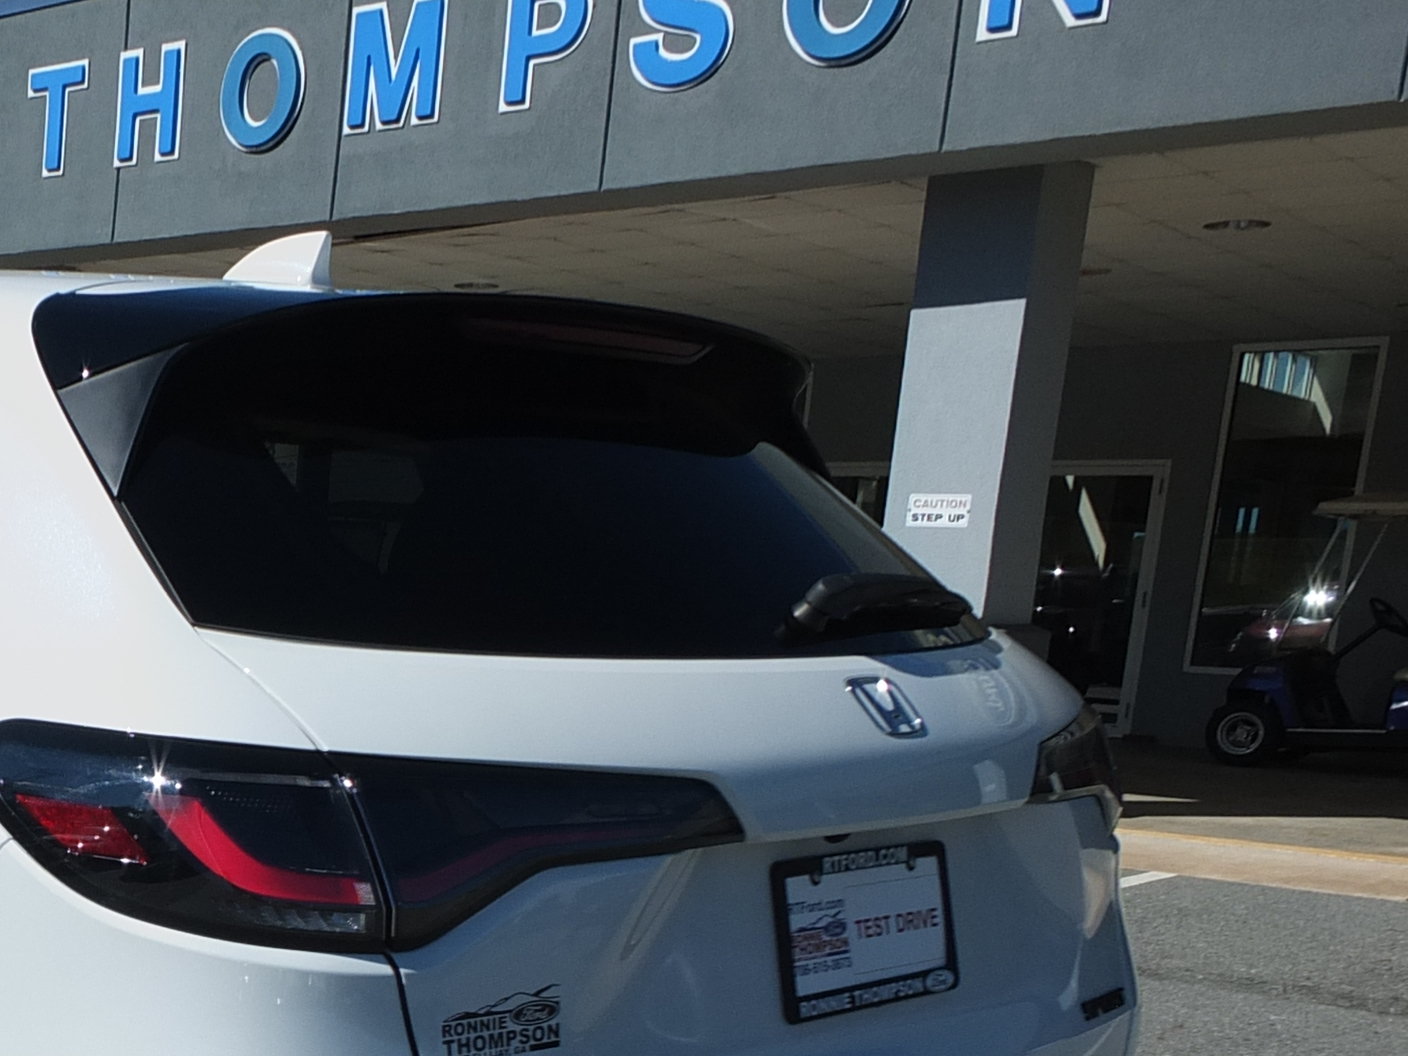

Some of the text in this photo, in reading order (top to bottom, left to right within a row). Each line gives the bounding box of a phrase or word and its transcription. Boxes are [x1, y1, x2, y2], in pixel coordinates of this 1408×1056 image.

[27, 0, 1110, 178] THOMPS
[912, 498, 967, 509] CAUTION
[911, 512, 965, 523] STEP UP
[854, 915, 891, 939] TEST
[895, 907, 939, 933] DRIVE
[442, 1015, 508, 1038] RONNIE
[442, 1022, 560, 1056] THOMPSON
